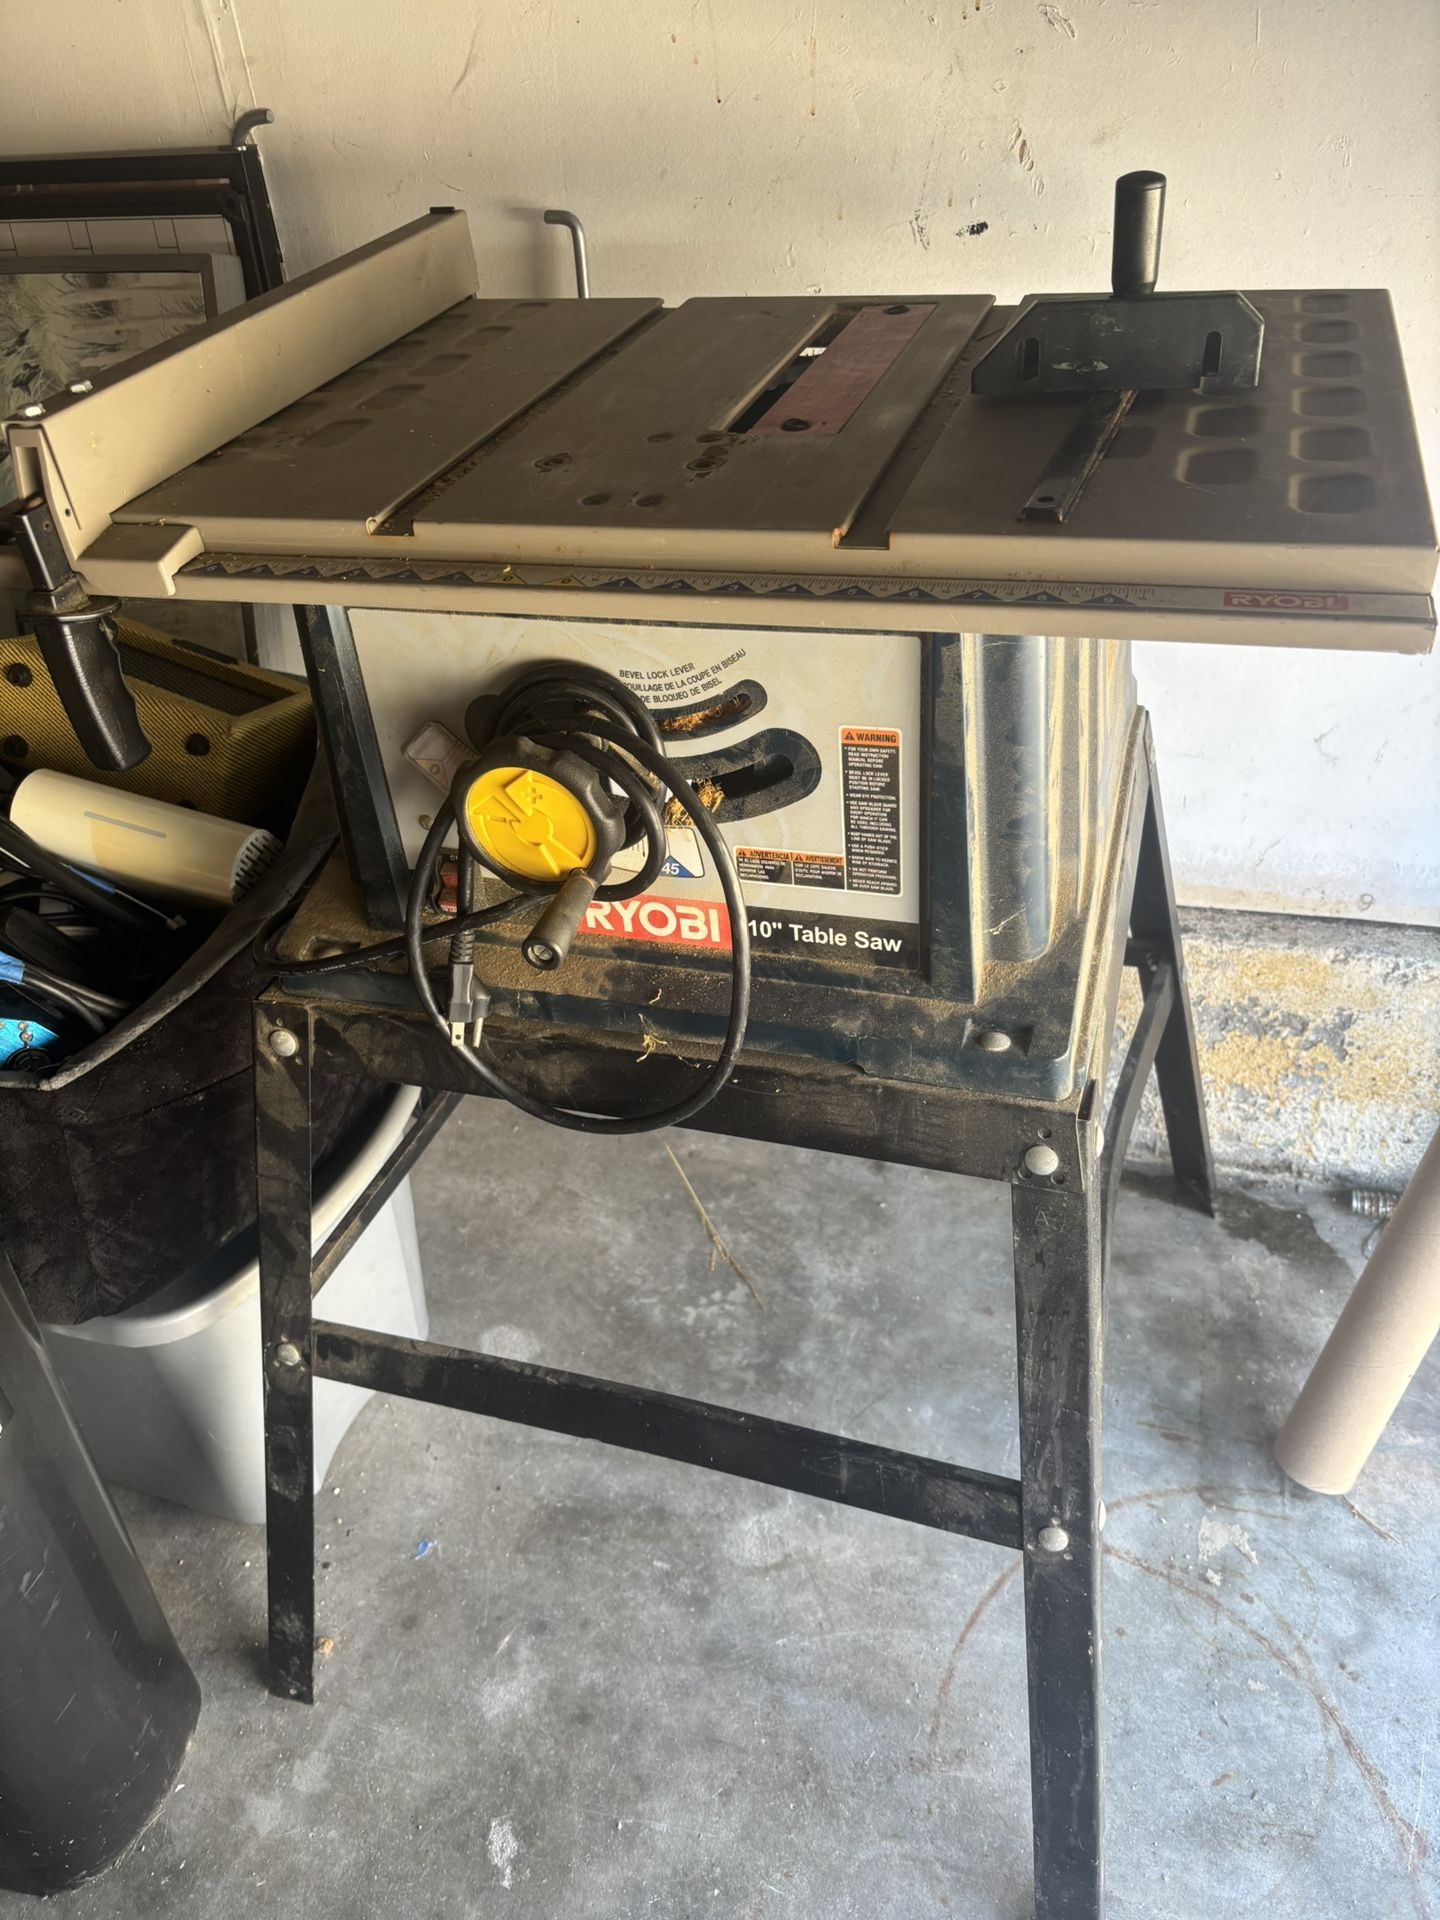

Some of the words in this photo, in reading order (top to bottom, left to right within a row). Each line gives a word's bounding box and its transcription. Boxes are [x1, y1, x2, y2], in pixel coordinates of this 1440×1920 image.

[1230, 593, 1336, 608] RYOBI
[619, 670, 644, 679] BEVEL
[646, 670, 668, 680] LOCK
[670, 662, 695, 676] LEVER
[665, 682, 675, 690] DE
[675, 680, 687, 689] LA
[687, 669, 712, 685] COUPE
[710, 664, 721, 674] EN
[721, 648, 746, 668] BISEAU
[653, 692, 689, 703] BLOQUEO
[690, 686, 701, 696] DE
[702, 677, 723, 692] BISEL
[856, 732, 896, 743] WARNING
[750, 850, 789, 860] ADVERTENCIA
[806, 855, 842, 864] AVERTISSEMENT
[661, 863, 679, 875] 45
[586, 900, 721, 942] RYOBI
[748, 919, 782, 938] 10"
[788, 922, 847, 947] Table
[854, 931, 902, 952] Saw
